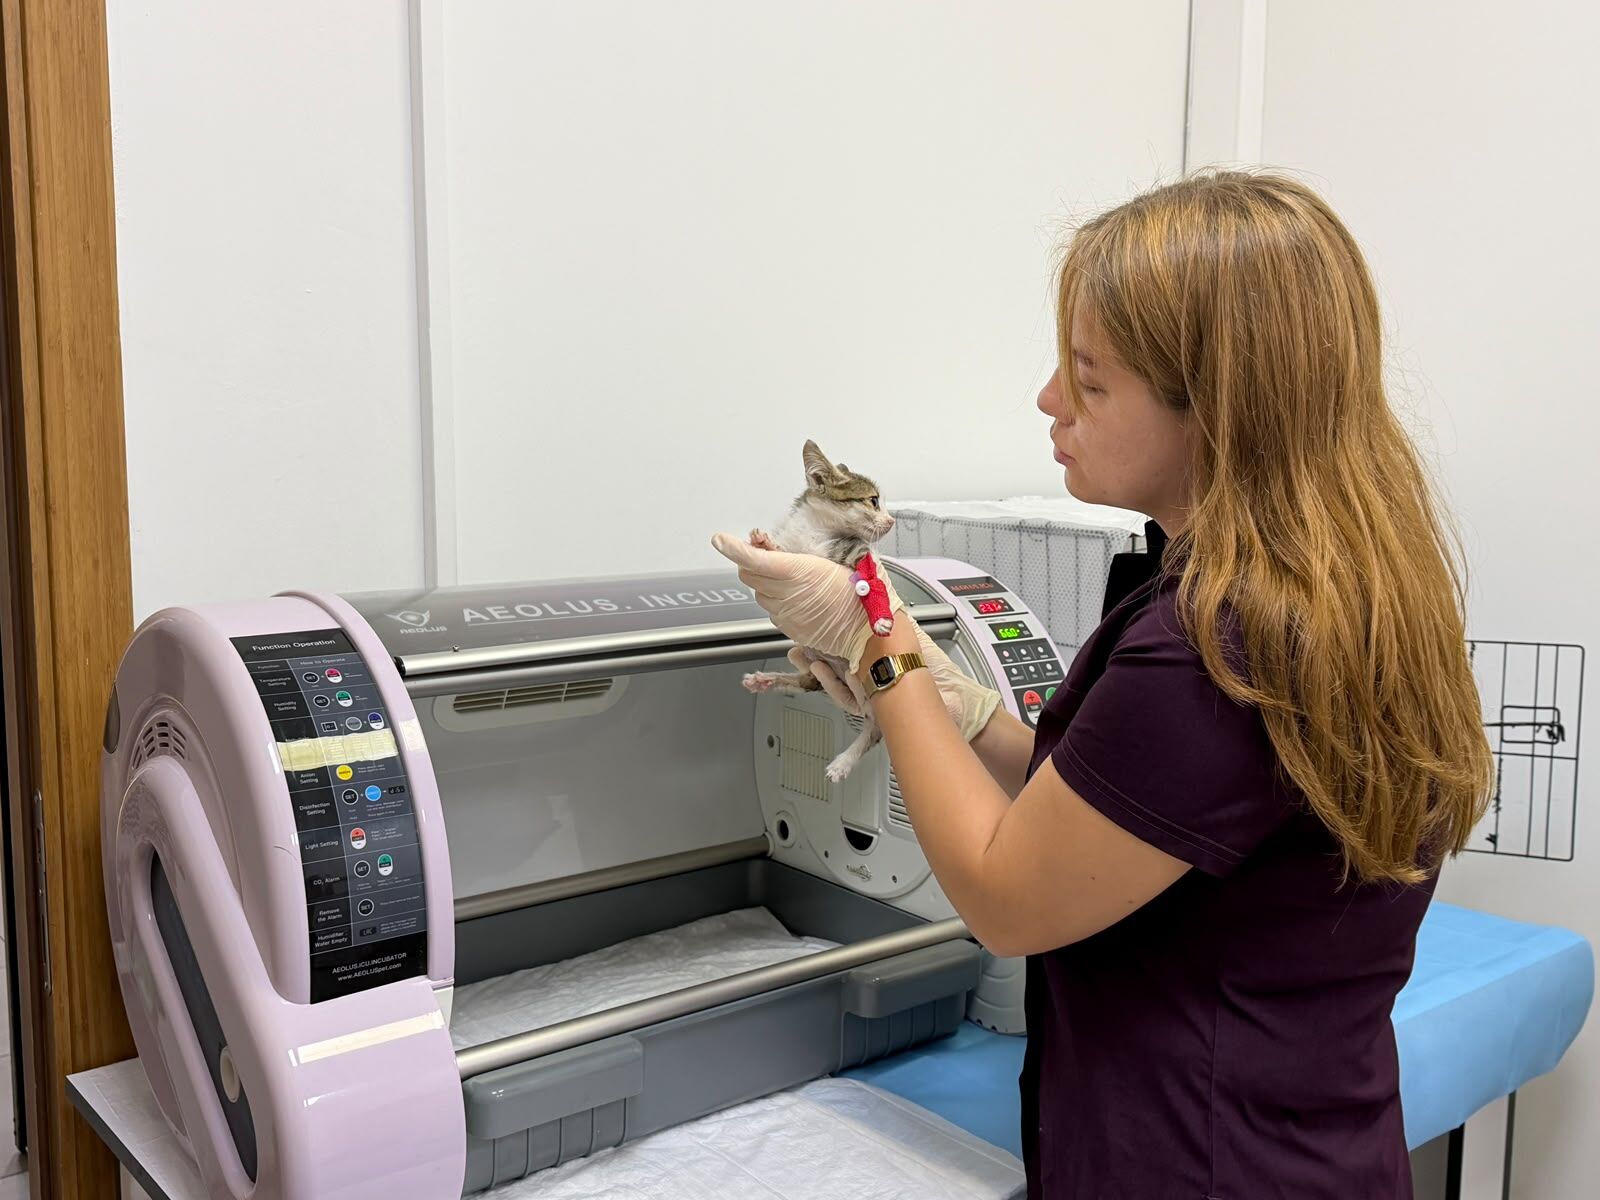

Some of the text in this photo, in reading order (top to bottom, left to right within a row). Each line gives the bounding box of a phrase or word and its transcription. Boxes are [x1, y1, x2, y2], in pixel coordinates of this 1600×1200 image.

[400, 624, 448, 635] AEOLUS
[252, 639, 336, 651] Function Operation
[299, 802, 331, 811] Disinfection
[320, 840, 339, 848] Setting
[319, 908, 340, 916] Remove
[327, 913, 342, 921] Alarm
[317, 931, 344, 941] Humidifier
[314, 937, 348, 948] Water Empty
[337, 963, 402, 981] www.AEOLUSpet.com
